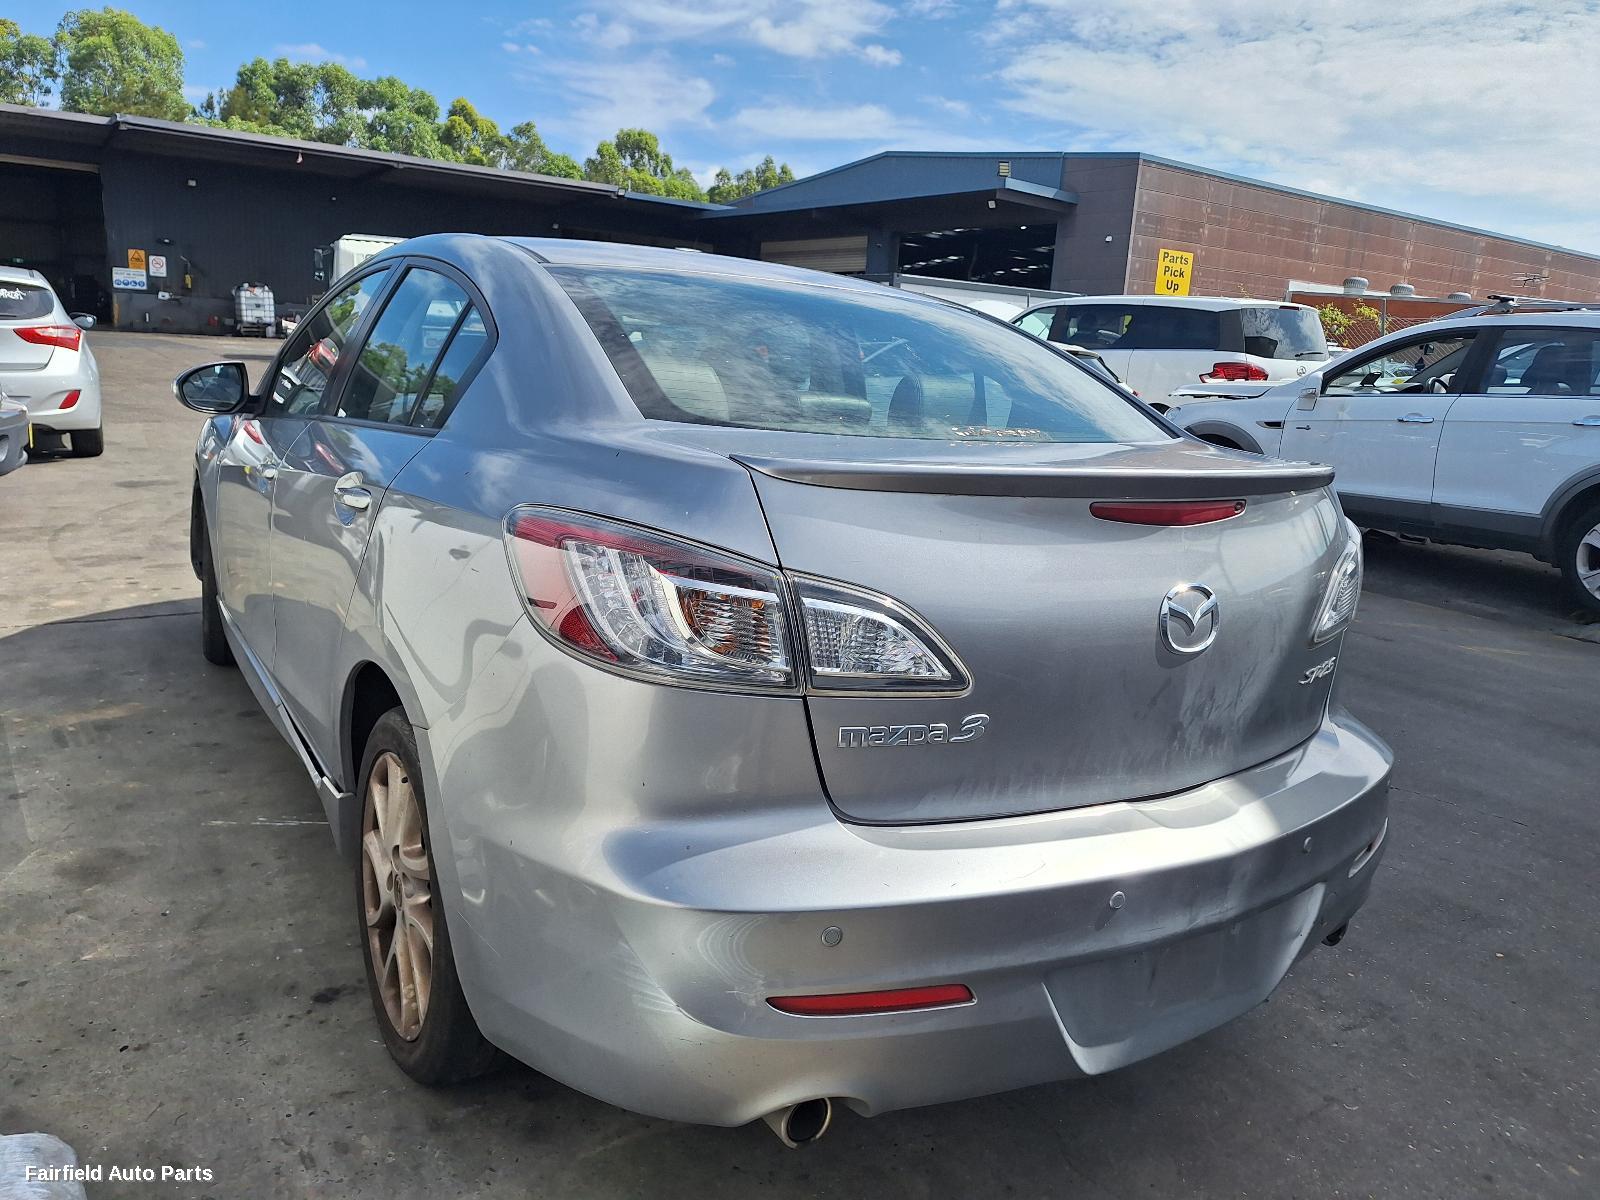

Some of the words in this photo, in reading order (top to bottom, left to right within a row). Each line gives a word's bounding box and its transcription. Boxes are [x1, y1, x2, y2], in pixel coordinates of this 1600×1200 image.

[1163, 252, 1189, 265] Parts
[1164, 266, 1184, 278] Pick
[1166, 280, 1179, 293] Up
[838, 723, 949, 748] mazda
